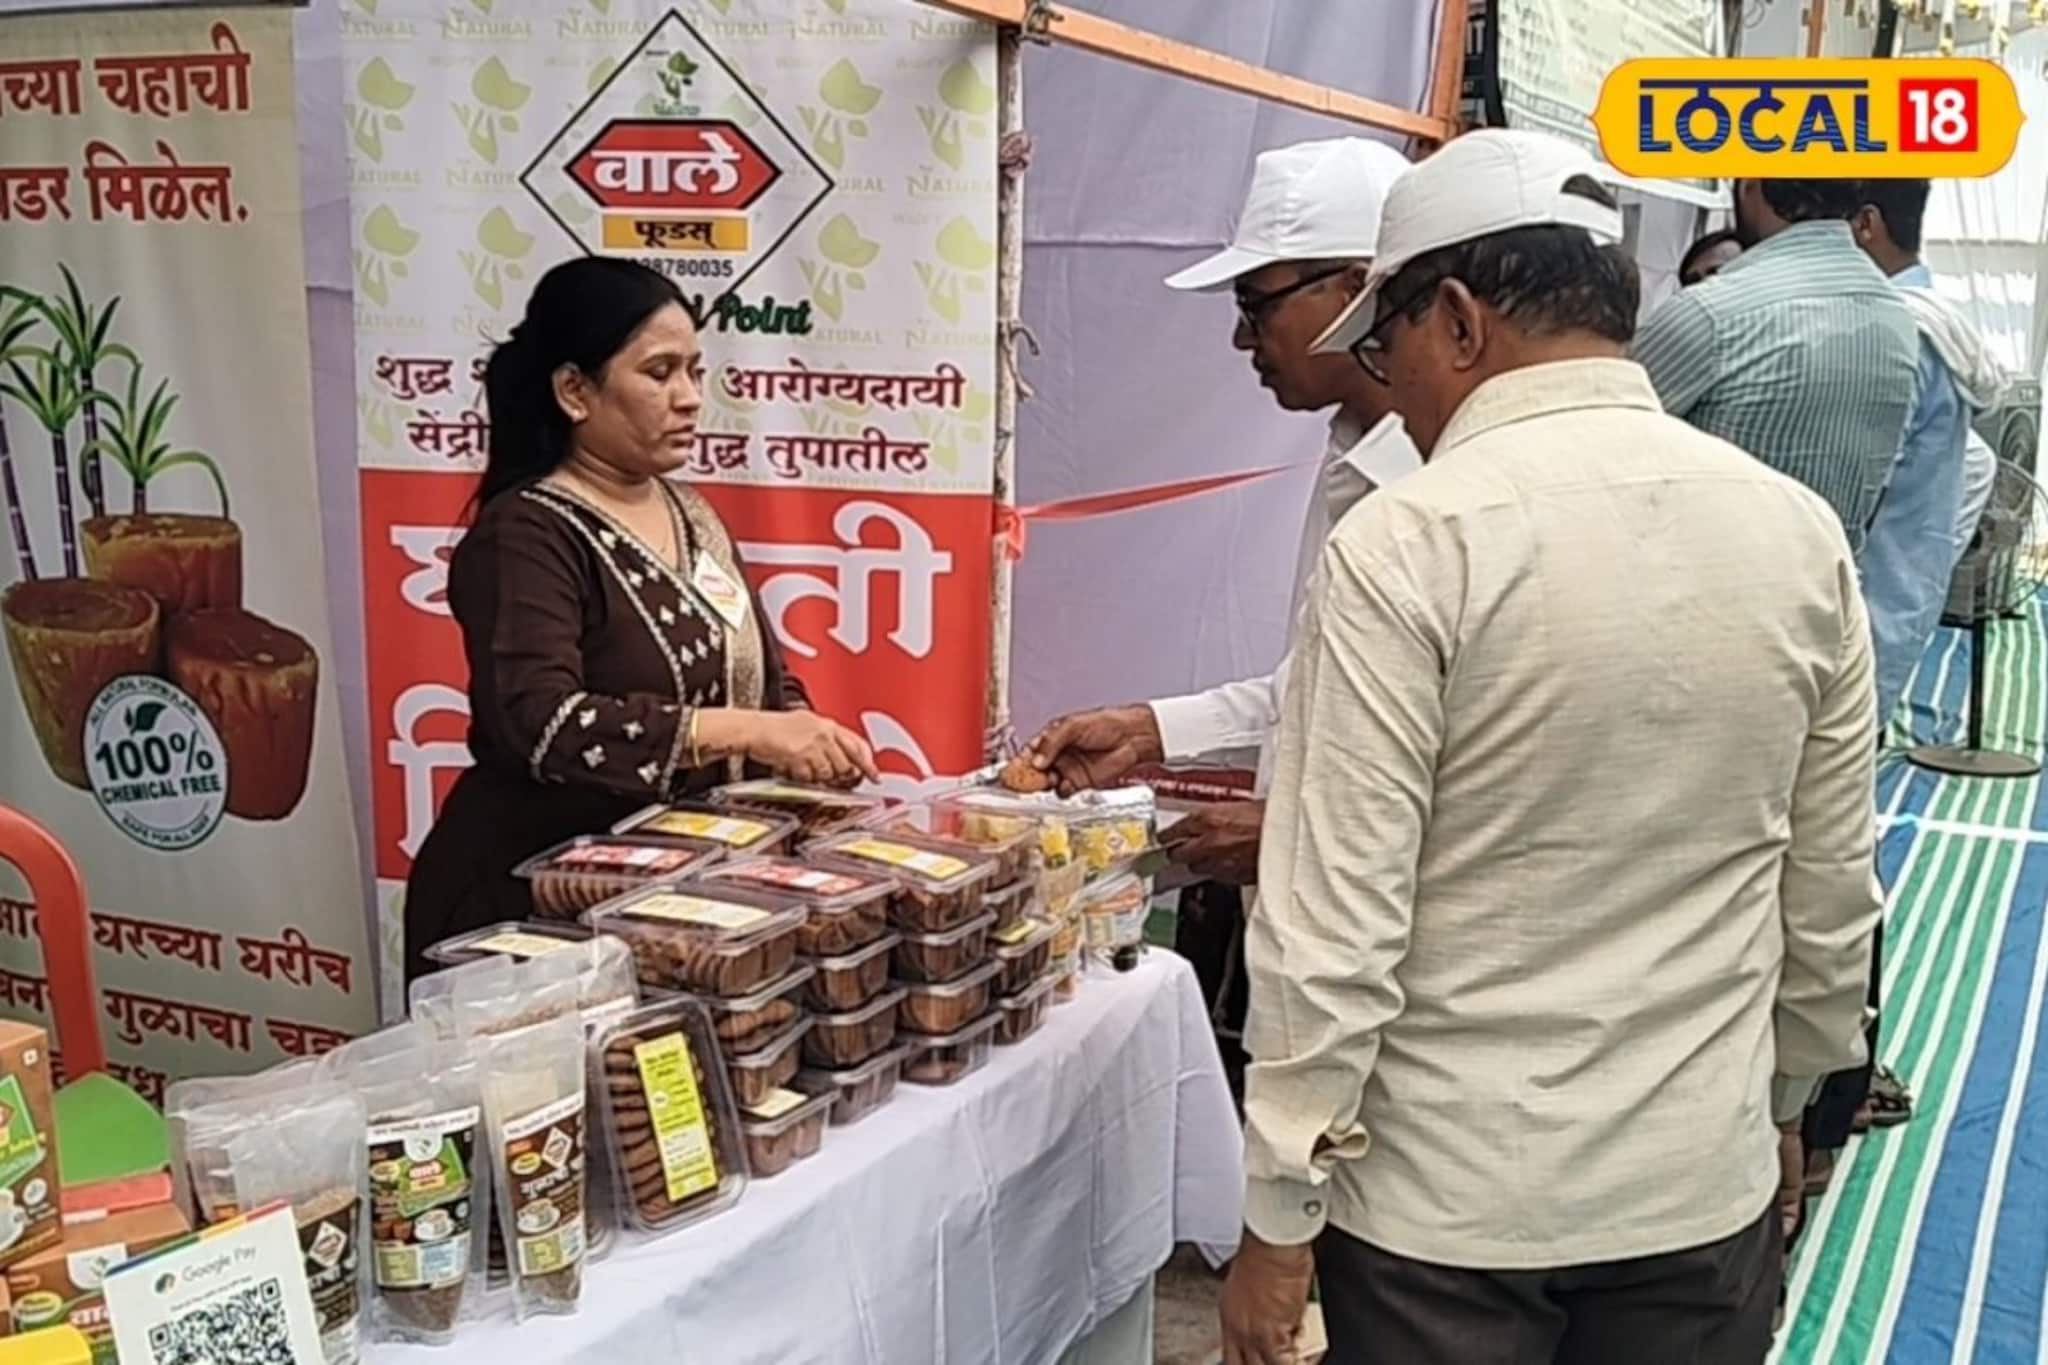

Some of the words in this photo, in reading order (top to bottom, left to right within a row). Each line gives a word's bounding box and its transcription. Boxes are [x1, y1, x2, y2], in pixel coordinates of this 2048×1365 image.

[95, 22, 251, 117] चहाची
[84, 140, 248, 221] मिळेल.
[590, 131, 741, 192] वाले
[634, 220, 717, 248] फूडस्
[715, 292, 813, 335] Point
[375, 356, 453, 400] शुद्ध
[721, 357, 966, 410] आरोग्यदायी
[765, 427, 930, 478] तुपातील
[96, 729, 213, 781] 100%
[101, 780, 178, 805] CHEMICAL
[180, 774, 221, 795] FREE
[90, 912, 222, 971] घरच्या
[237, 928, 352, 993] घरीच
[103, 988, 252, 1051] गुळाचा
